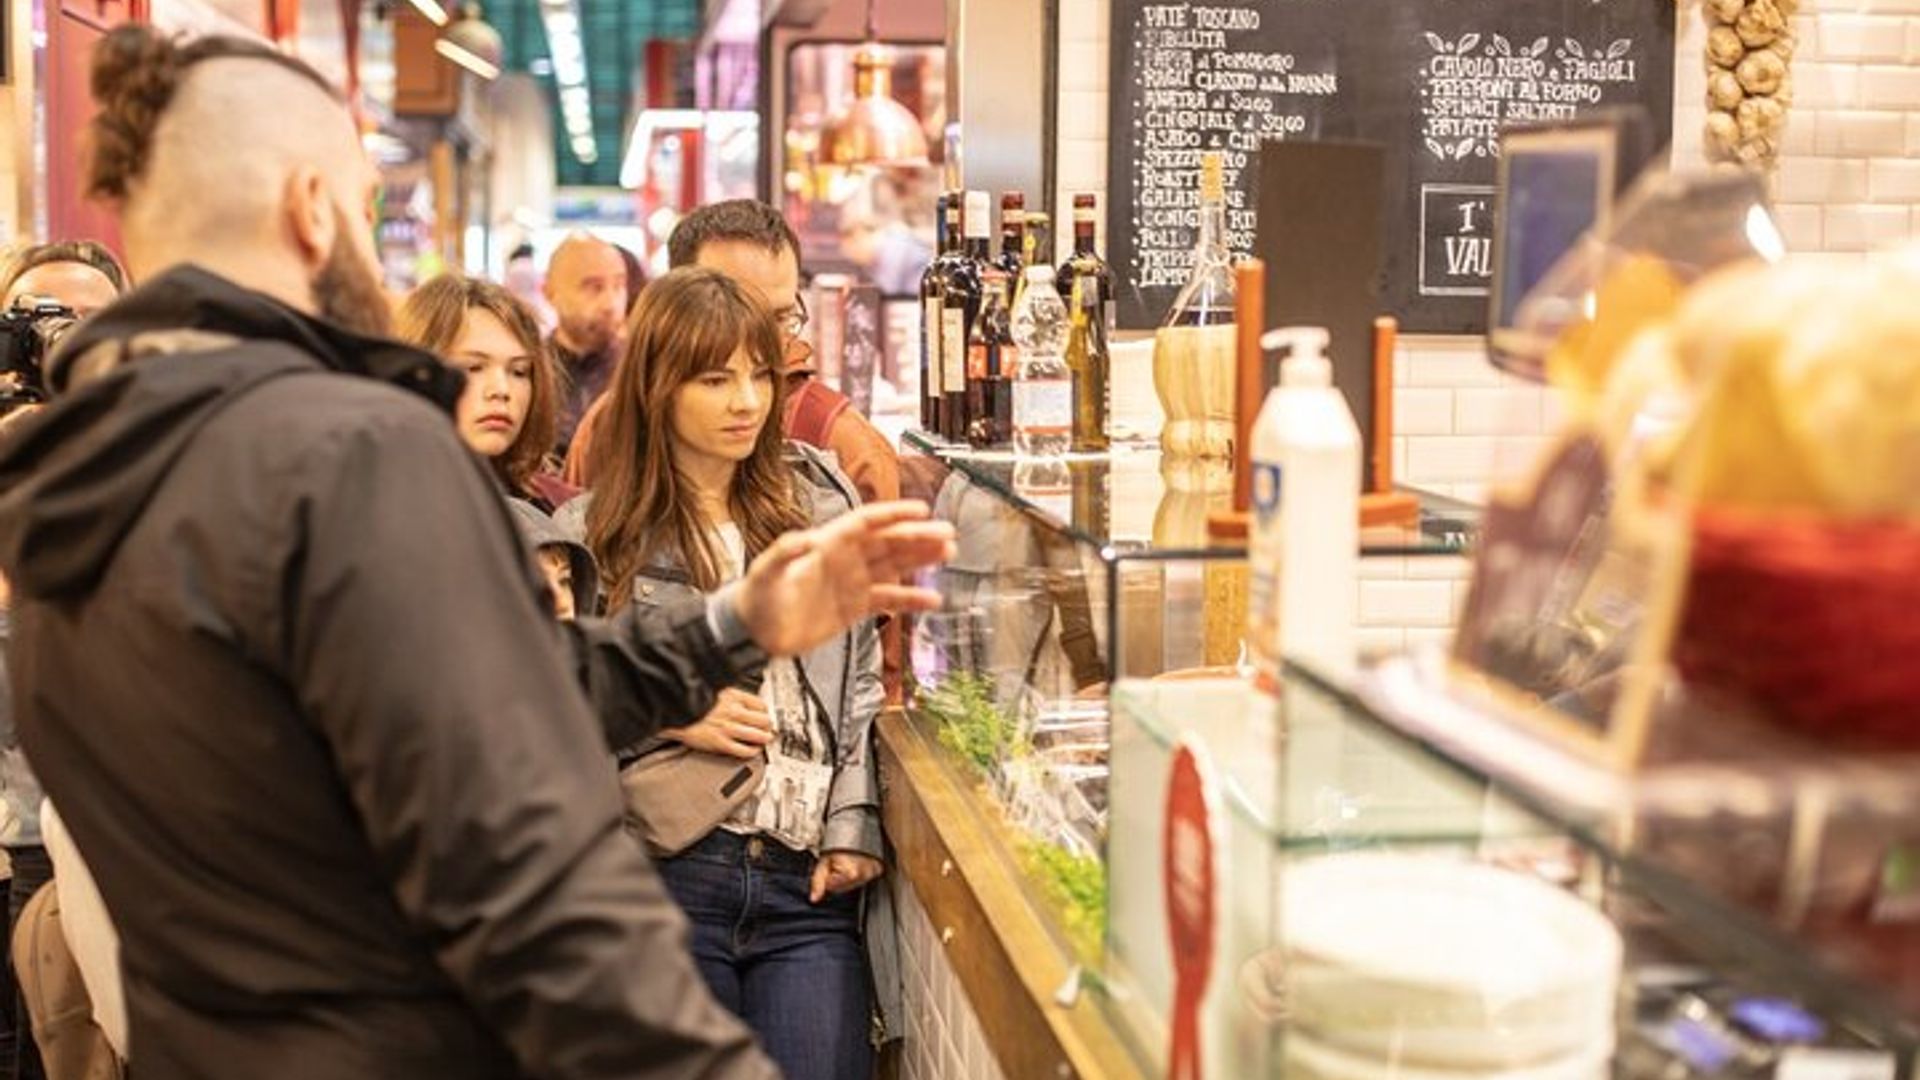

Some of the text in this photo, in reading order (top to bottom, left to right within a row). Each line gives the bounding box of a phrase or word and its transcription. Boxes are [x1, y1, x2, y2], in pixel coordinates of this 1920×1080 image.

[1192, 8, 1260, 29] TOSCANO
[1431, 56, 1494, 78] CAVOLO
[1497, 57, 1545, 79] NERO
[1563, 59, 1636, 81] FAGIOLI
[1429, 79, 1514, 99] PEPERONI
[1542, 82, 1602, 103] FORNO
[1430, 98, 1500, 118] SPINACI
[1428, 118, 1499, 138] PATATE
